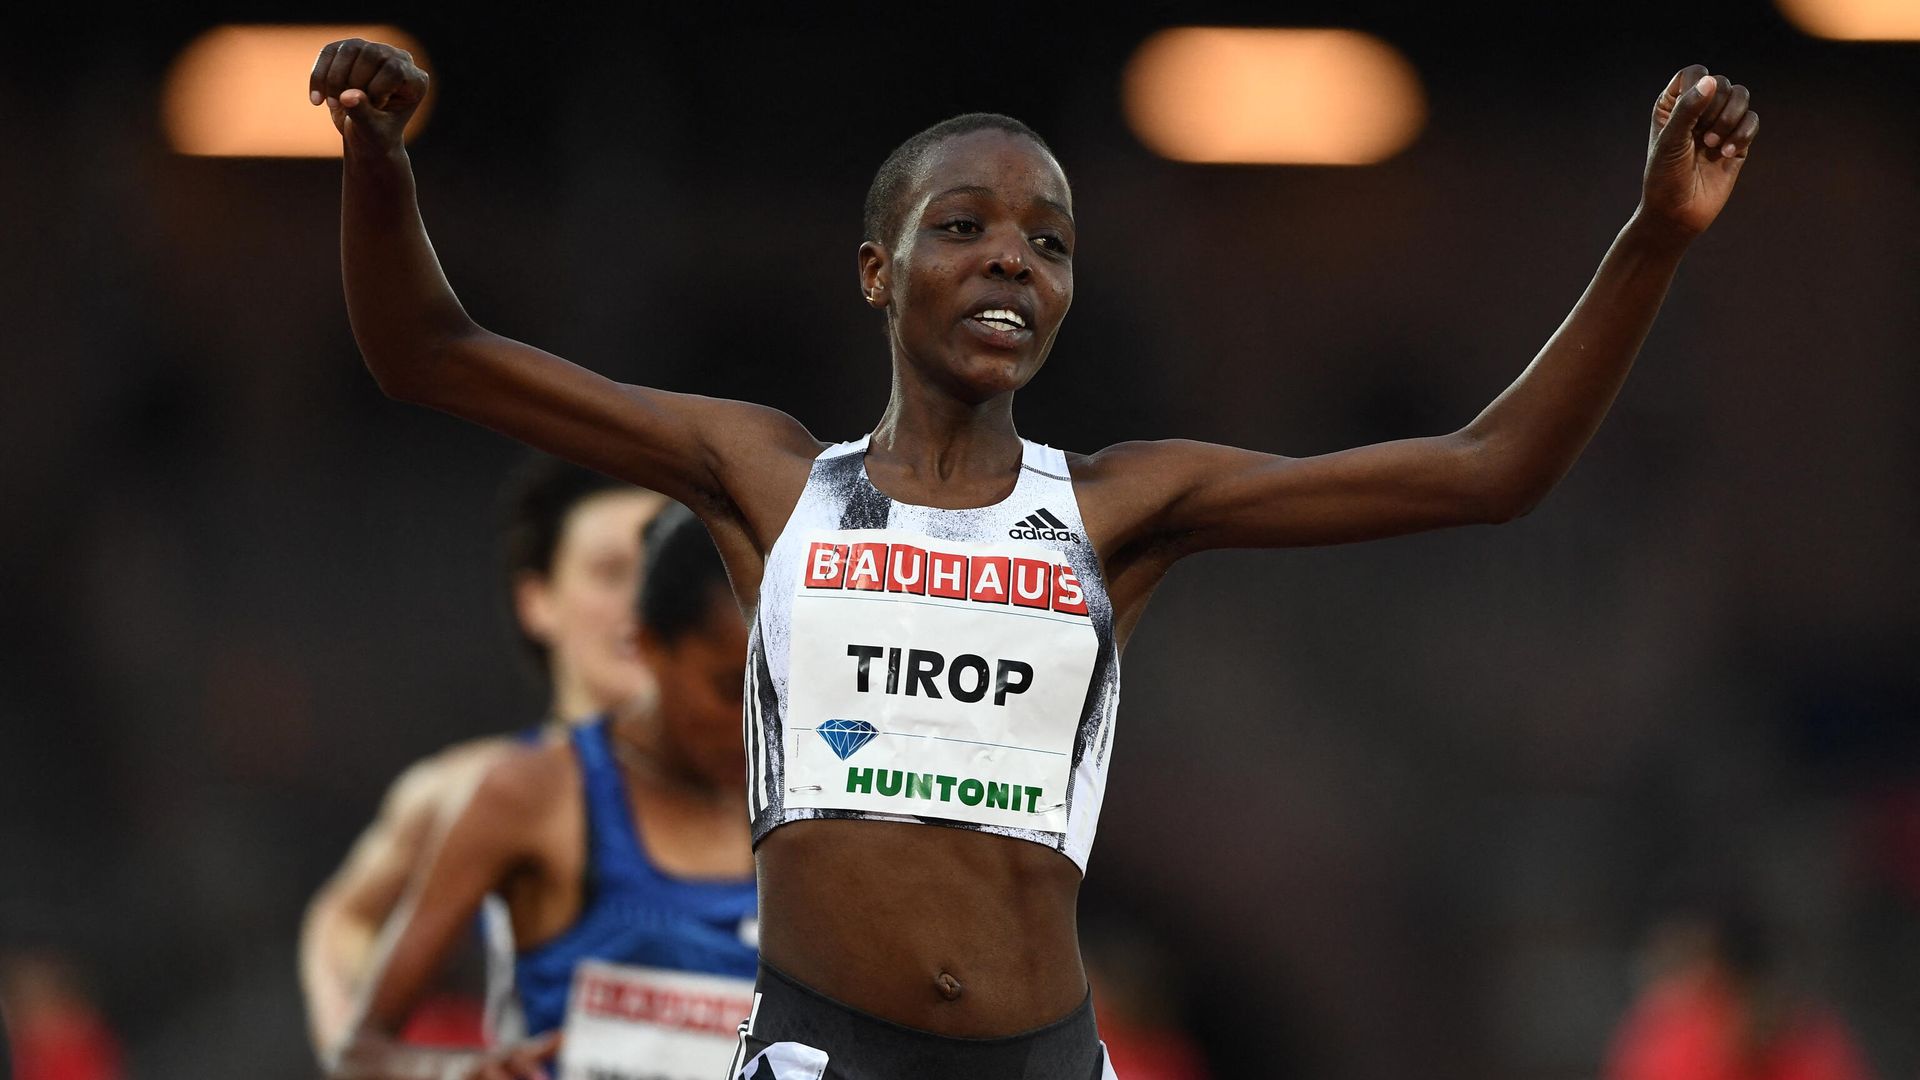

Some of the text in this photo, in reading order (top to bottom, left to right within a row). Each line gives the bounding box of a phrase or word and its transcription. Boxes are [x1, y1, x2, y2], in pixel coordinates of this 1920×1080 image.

[1009, 528, 1081, 544] adidas
[811, 548, 1084, 606] BAUHAUS
[847, 644, 1034, 706] TIROP
[846, 767, 1043, 813] HUNTONIT
